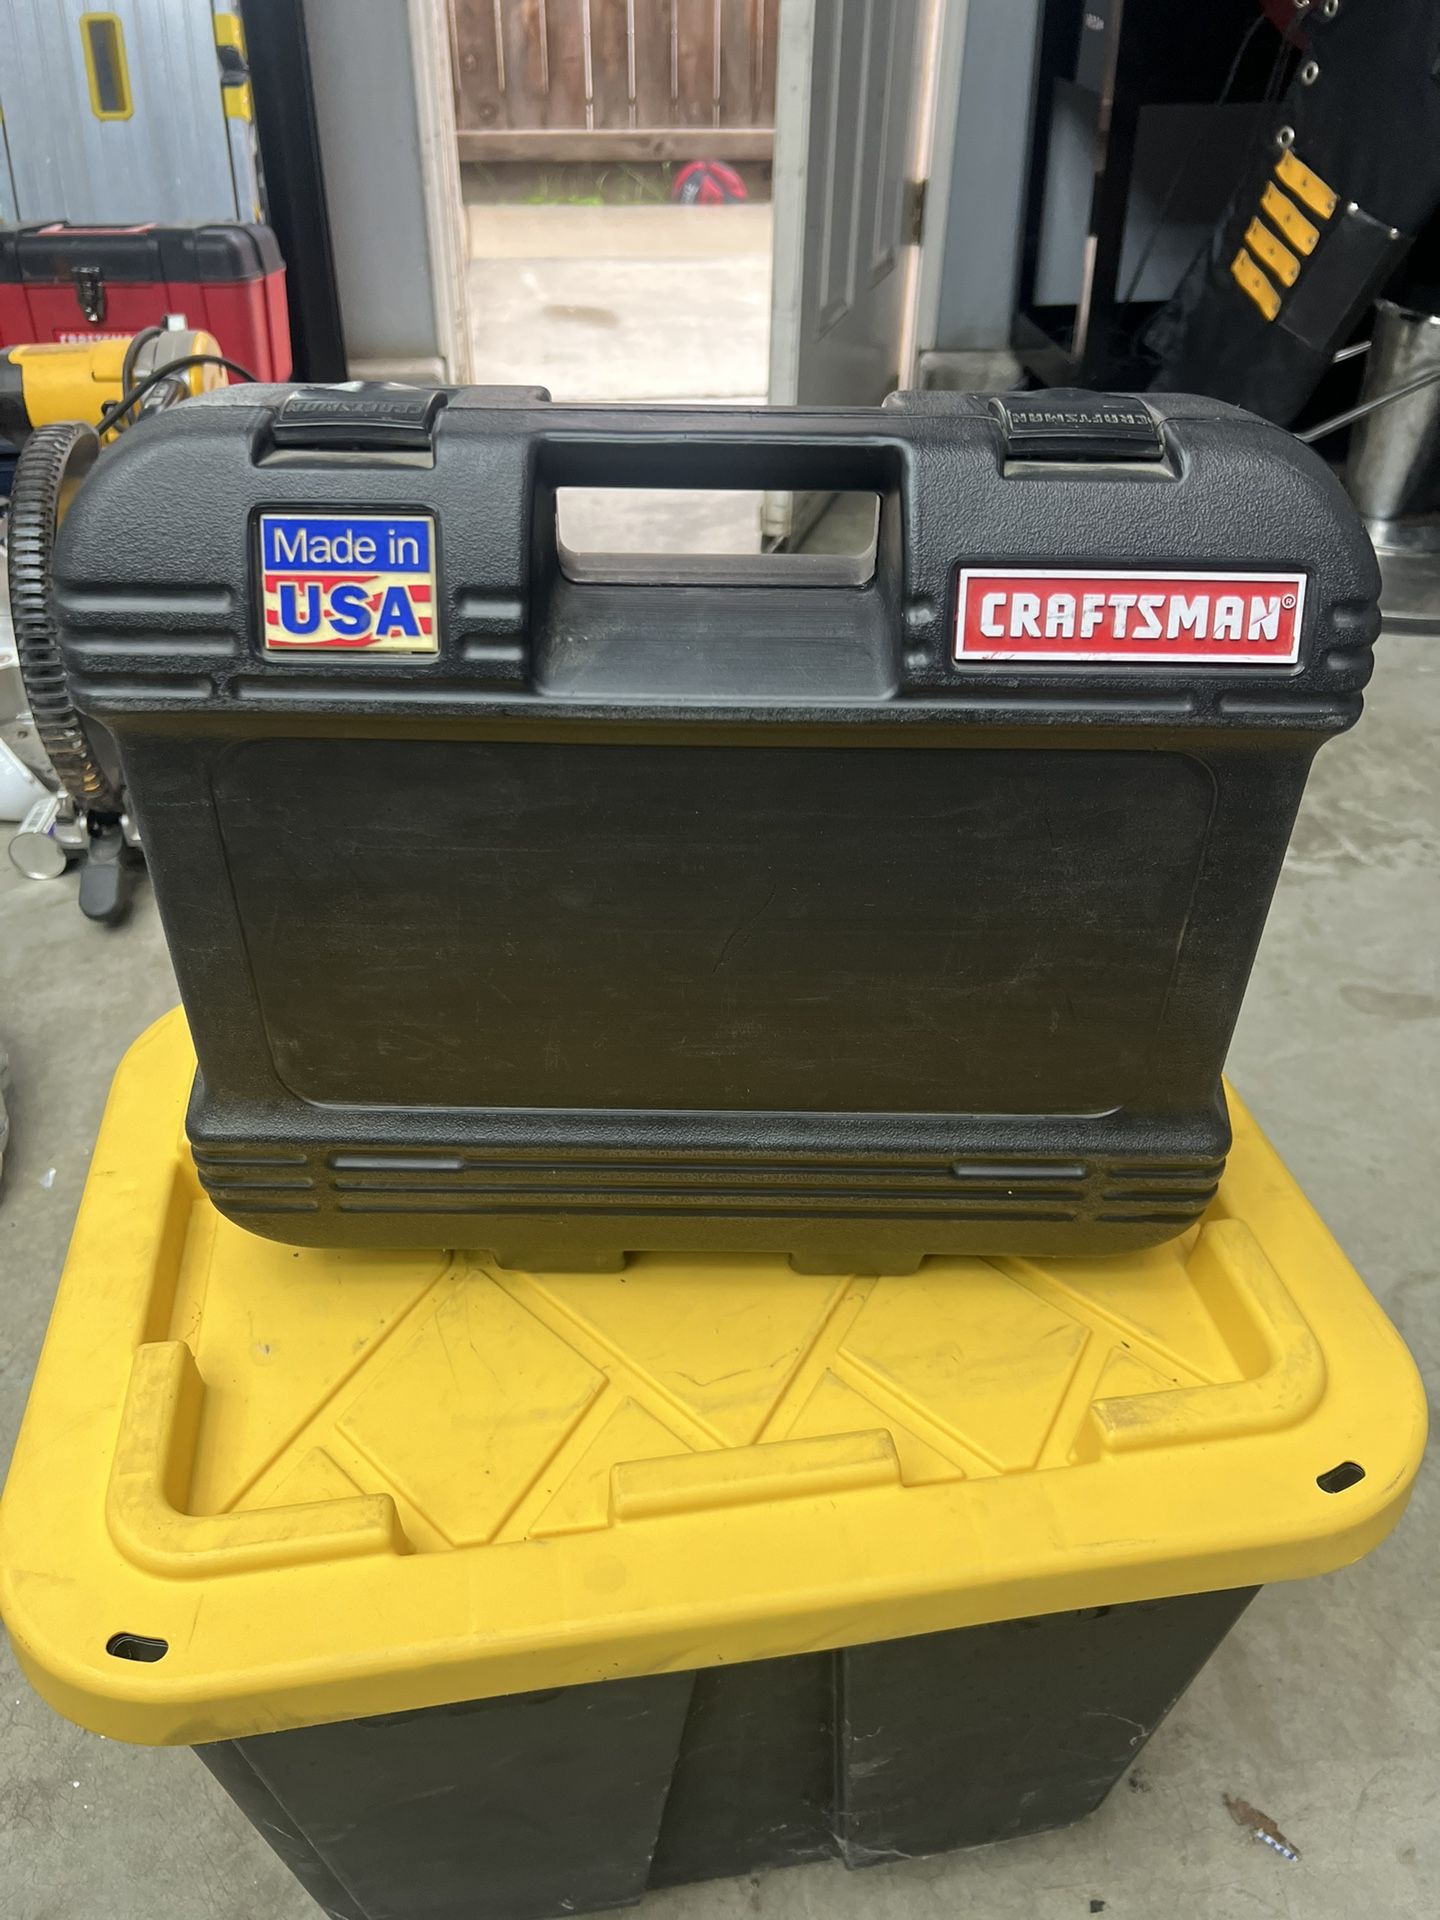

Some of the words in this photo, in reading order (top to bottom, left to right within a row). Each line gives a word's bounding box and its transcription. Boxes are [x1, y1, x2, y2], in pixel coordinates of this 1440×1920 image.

[273, 527, 377, 564] Made
[388, 528, 420, 565] in
[278, 582, 421, 637] USA
